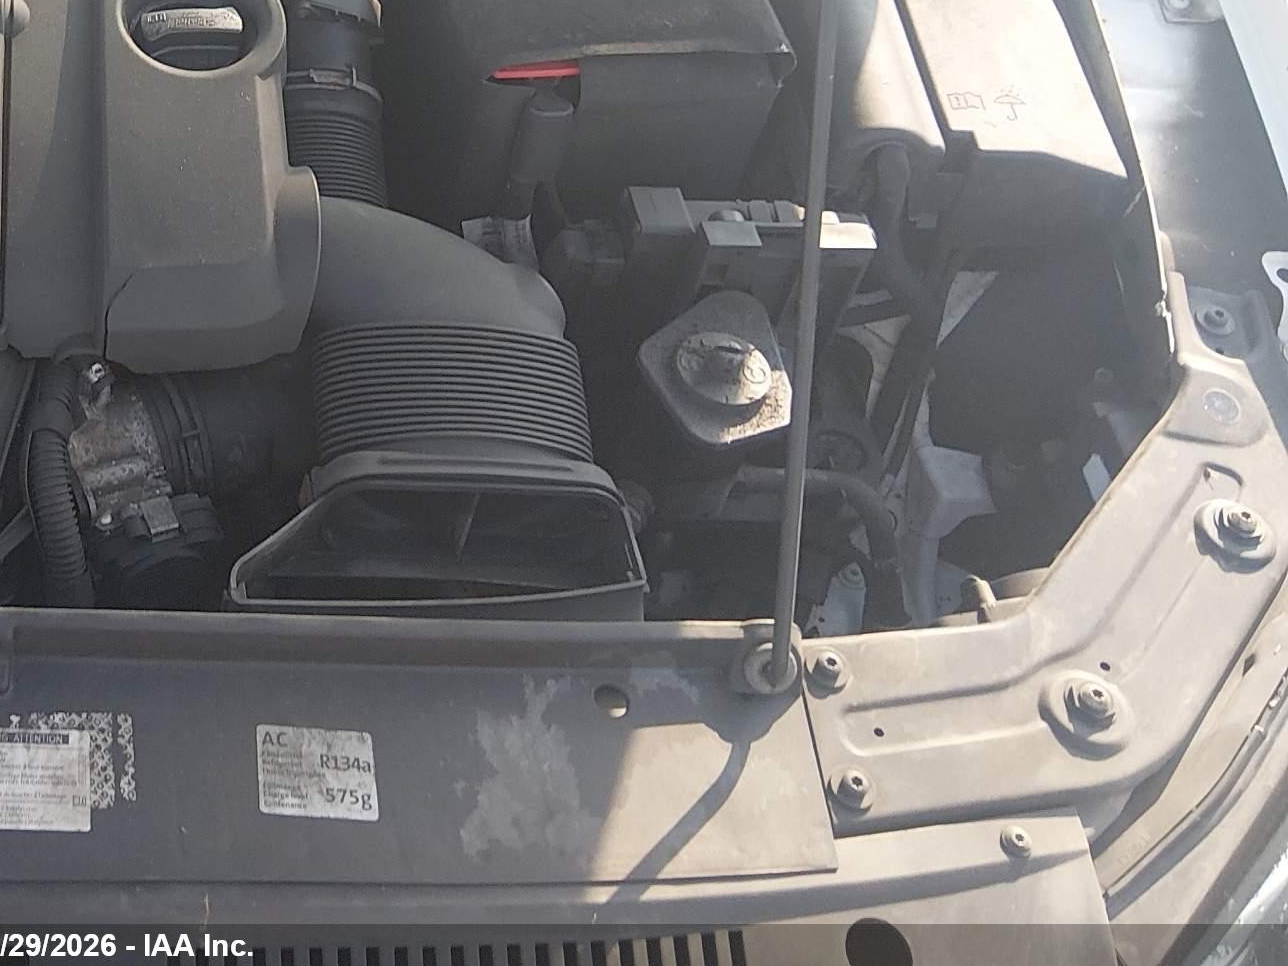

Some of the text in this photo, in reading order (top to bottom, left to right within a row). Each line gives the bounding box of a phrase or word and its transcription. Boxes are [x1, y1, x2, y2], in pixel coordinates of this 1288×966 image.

[262, 731, 288, 748] AC
[320, 753, 372, 774] R134a
[325, 787, 373, 811] 575g
